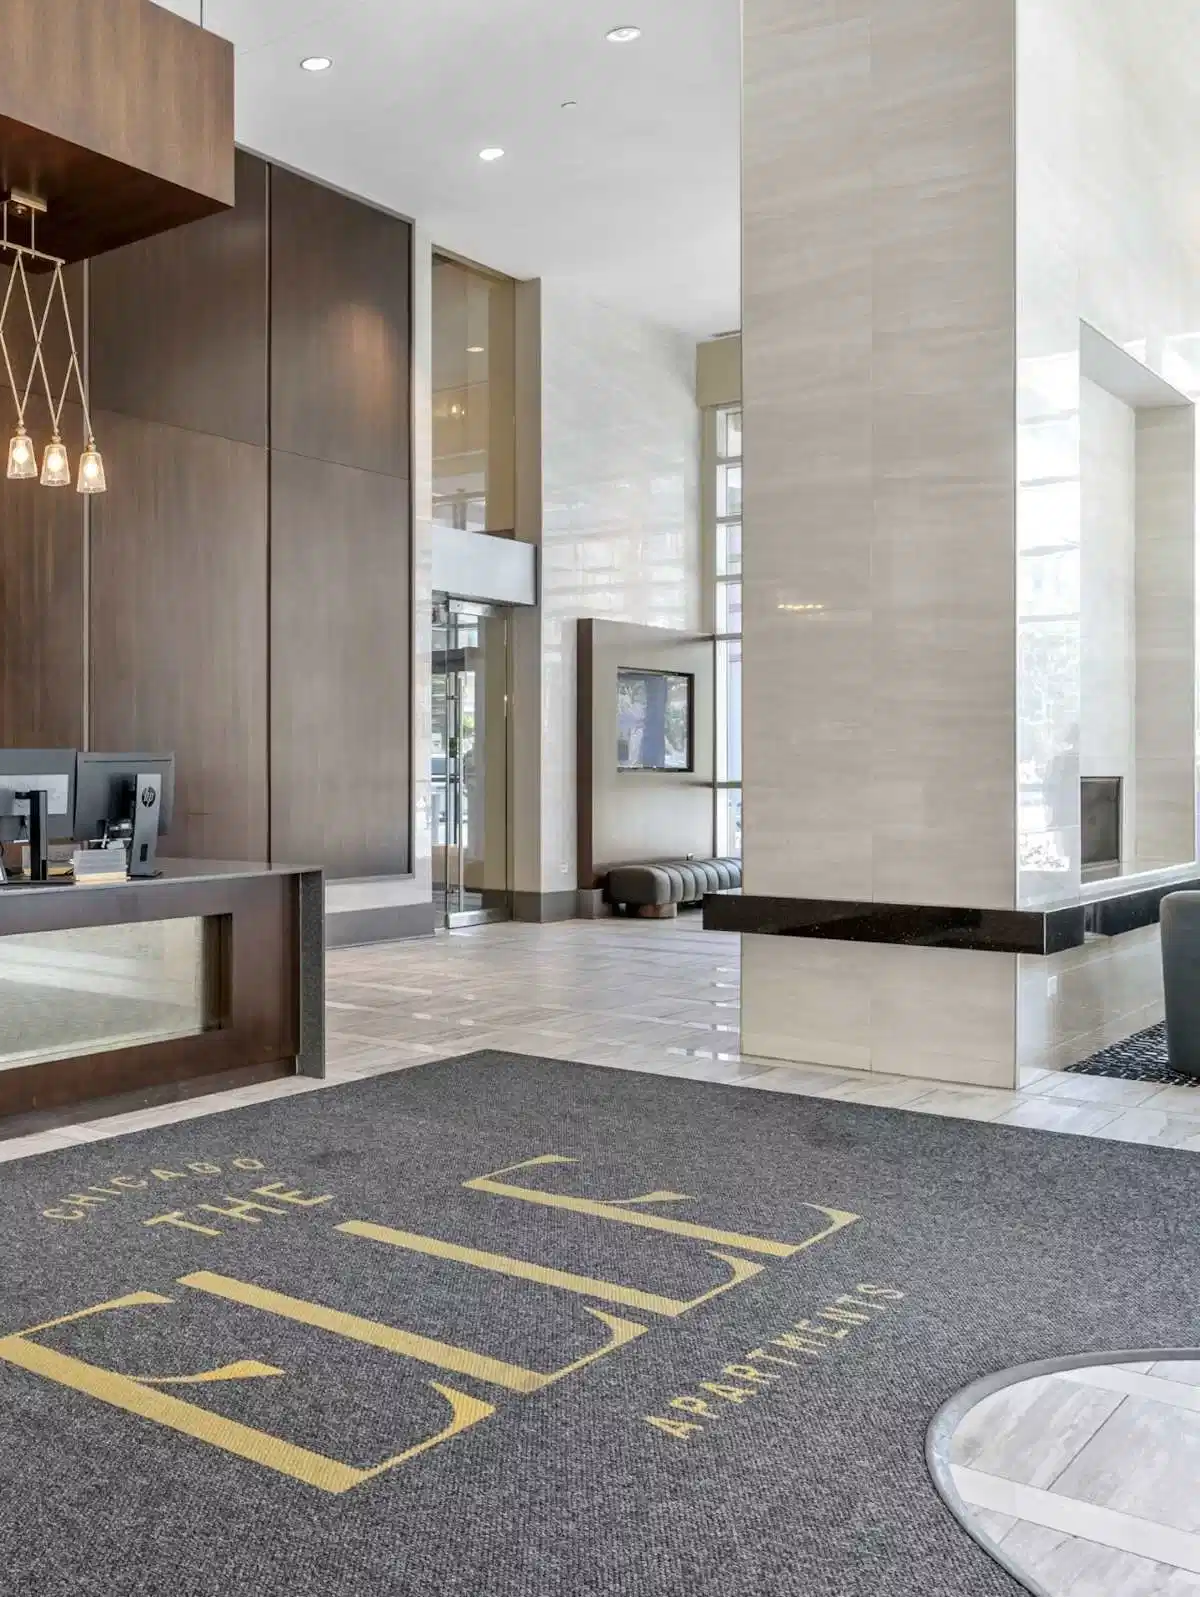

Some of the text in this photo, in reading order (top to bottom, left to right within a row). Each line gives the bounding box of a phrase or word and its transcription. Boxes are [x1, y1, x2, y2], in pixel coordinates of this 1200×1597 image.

[141, 786, 156, 807] hp
[41, 1157, 265, 1221] CHICAGO
[142, 1182, 335, 1237] THE
[644, 1283, 905, 1441] APARTMENTS
